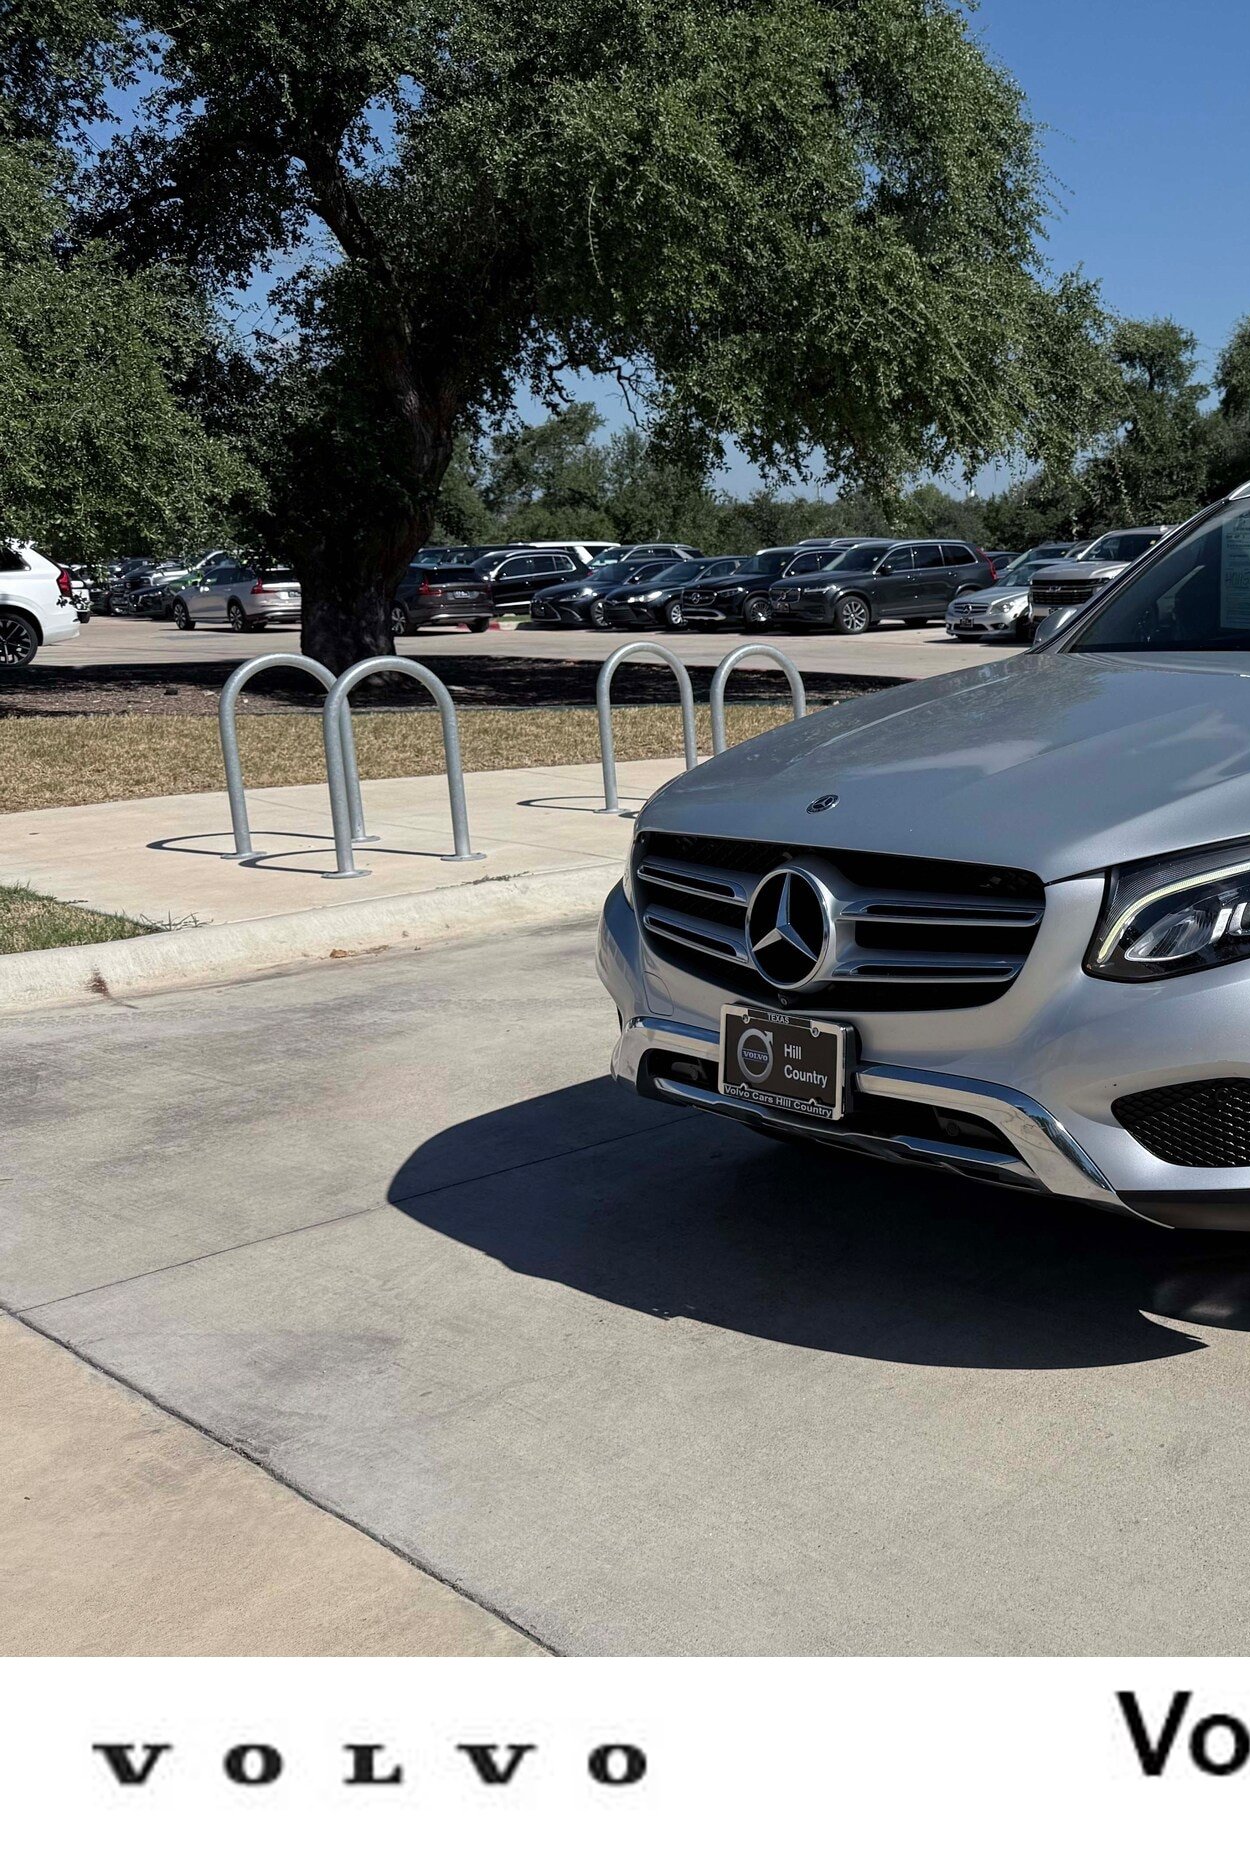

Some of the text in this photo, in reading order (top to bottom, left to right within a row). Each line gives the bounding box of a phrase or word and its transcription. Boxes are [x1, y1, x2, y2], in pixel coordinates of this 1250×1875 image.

[767, 1013, 790, 1024] TEXAS
[743, 1051, 768, 1061] VOLVO
[784, 1044, 802, 1060] Hill
[784, 1065, 828, 1088] Country
[725, 1085, 832, 1118] Volvo Cars Hill Country
